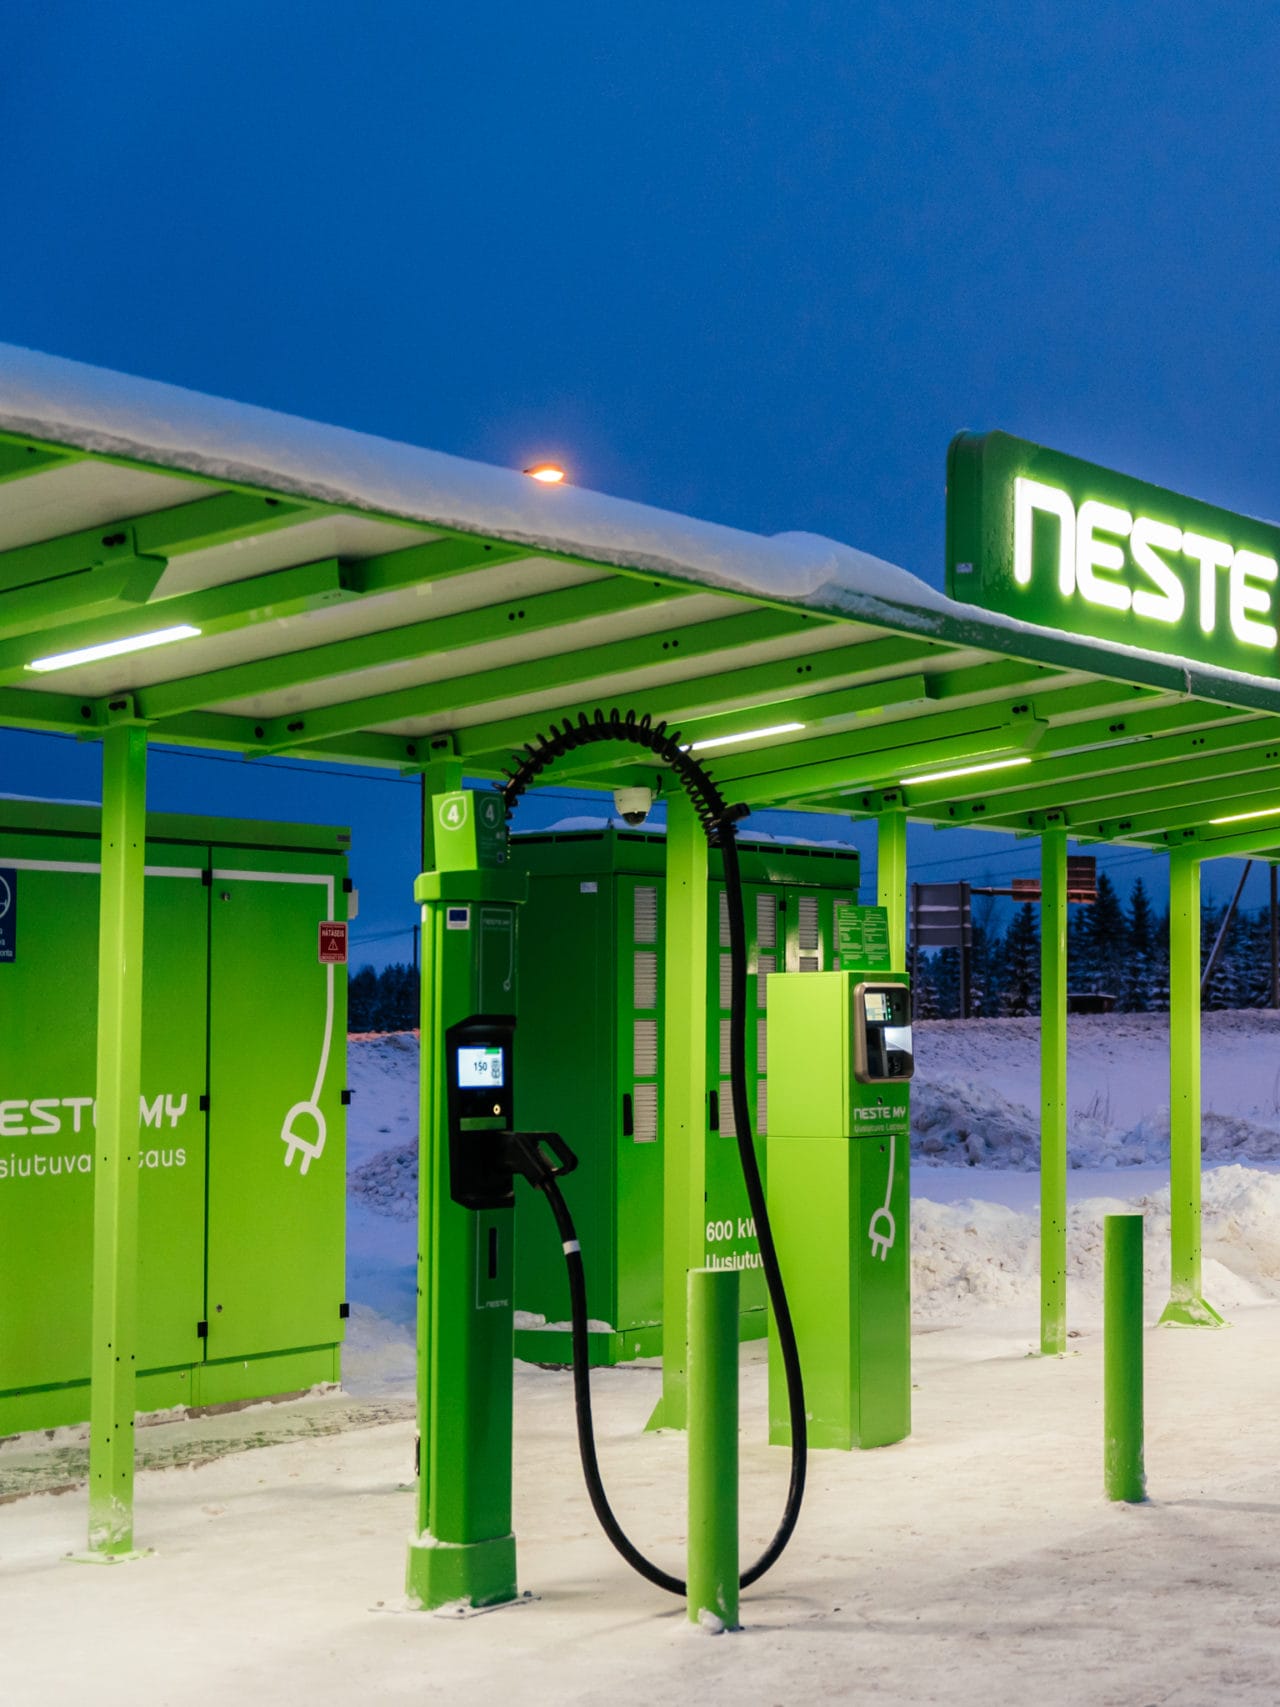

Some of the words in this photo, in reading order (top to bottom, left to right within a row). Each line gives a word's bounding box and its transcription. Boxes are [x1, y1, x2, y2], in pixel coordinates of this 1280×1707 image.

[1013, 475, 1279, 650] NESTE
[447, 804, 459, 823] 4
[473, 1061, 488, 1071] 150
[138, 1093, 188, 1129] MY
[853, 1106, 892, 1121] NESTE
[892, 1105, 906, 1119] MY
[706, 1219, 734, 1242] 600
